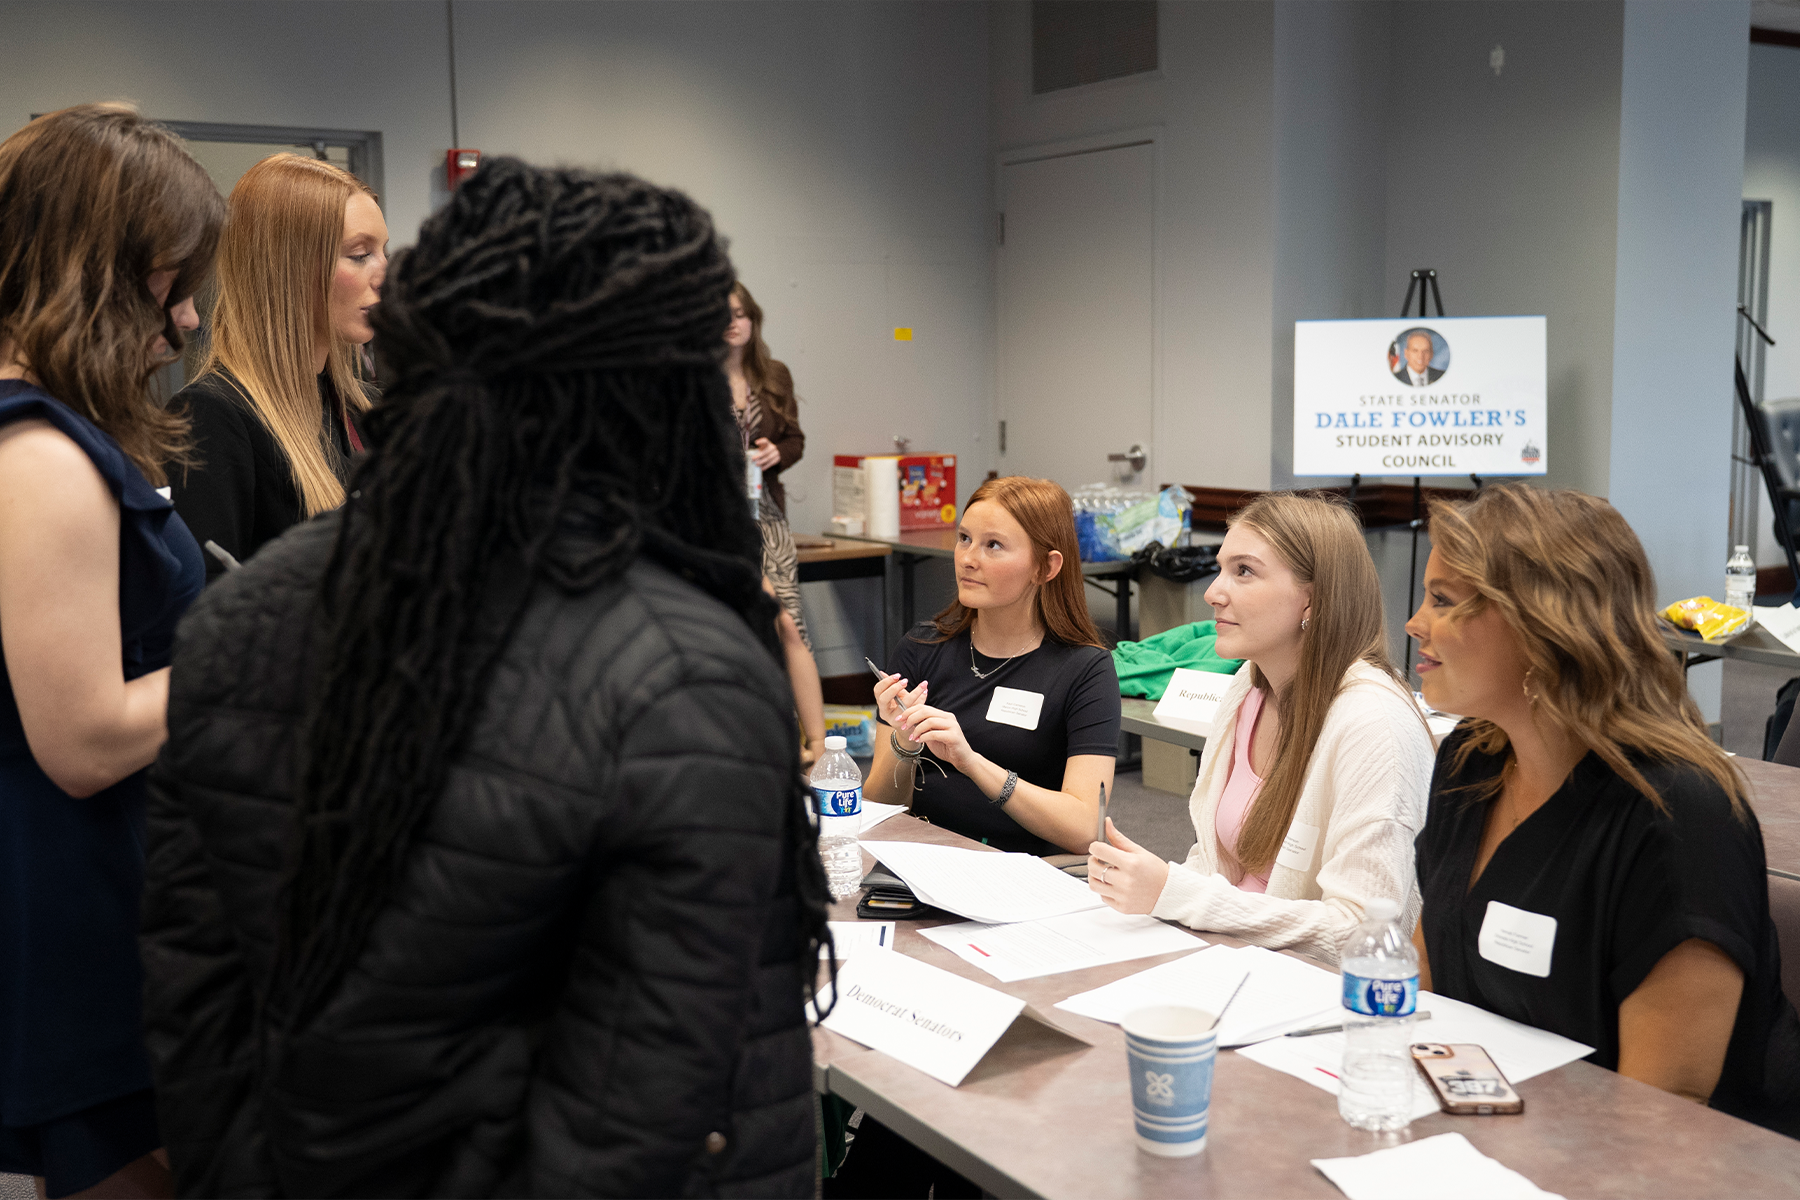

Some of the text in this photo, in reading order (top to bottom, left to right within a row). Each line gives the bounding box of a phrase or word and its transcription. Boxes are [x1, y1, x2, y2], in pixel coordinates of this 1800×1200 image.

[1358, 393, 1481, 407] STATE SENATOR
[1315, 409, 1527, 429] DALE FOWLER'S
[1336, 433, 1504, 448] STUDENT ADVISORY
[1382, 454, 1456, 468] COUNCIL
[836, 790, 855, 800] Pure
[838, 797, 854, 808] Life
[1371, 979, 1403, 993] Pure
[1374, 990, 1400, 1005] Life
[846, 983, 965, 1043] Democrat Senators
